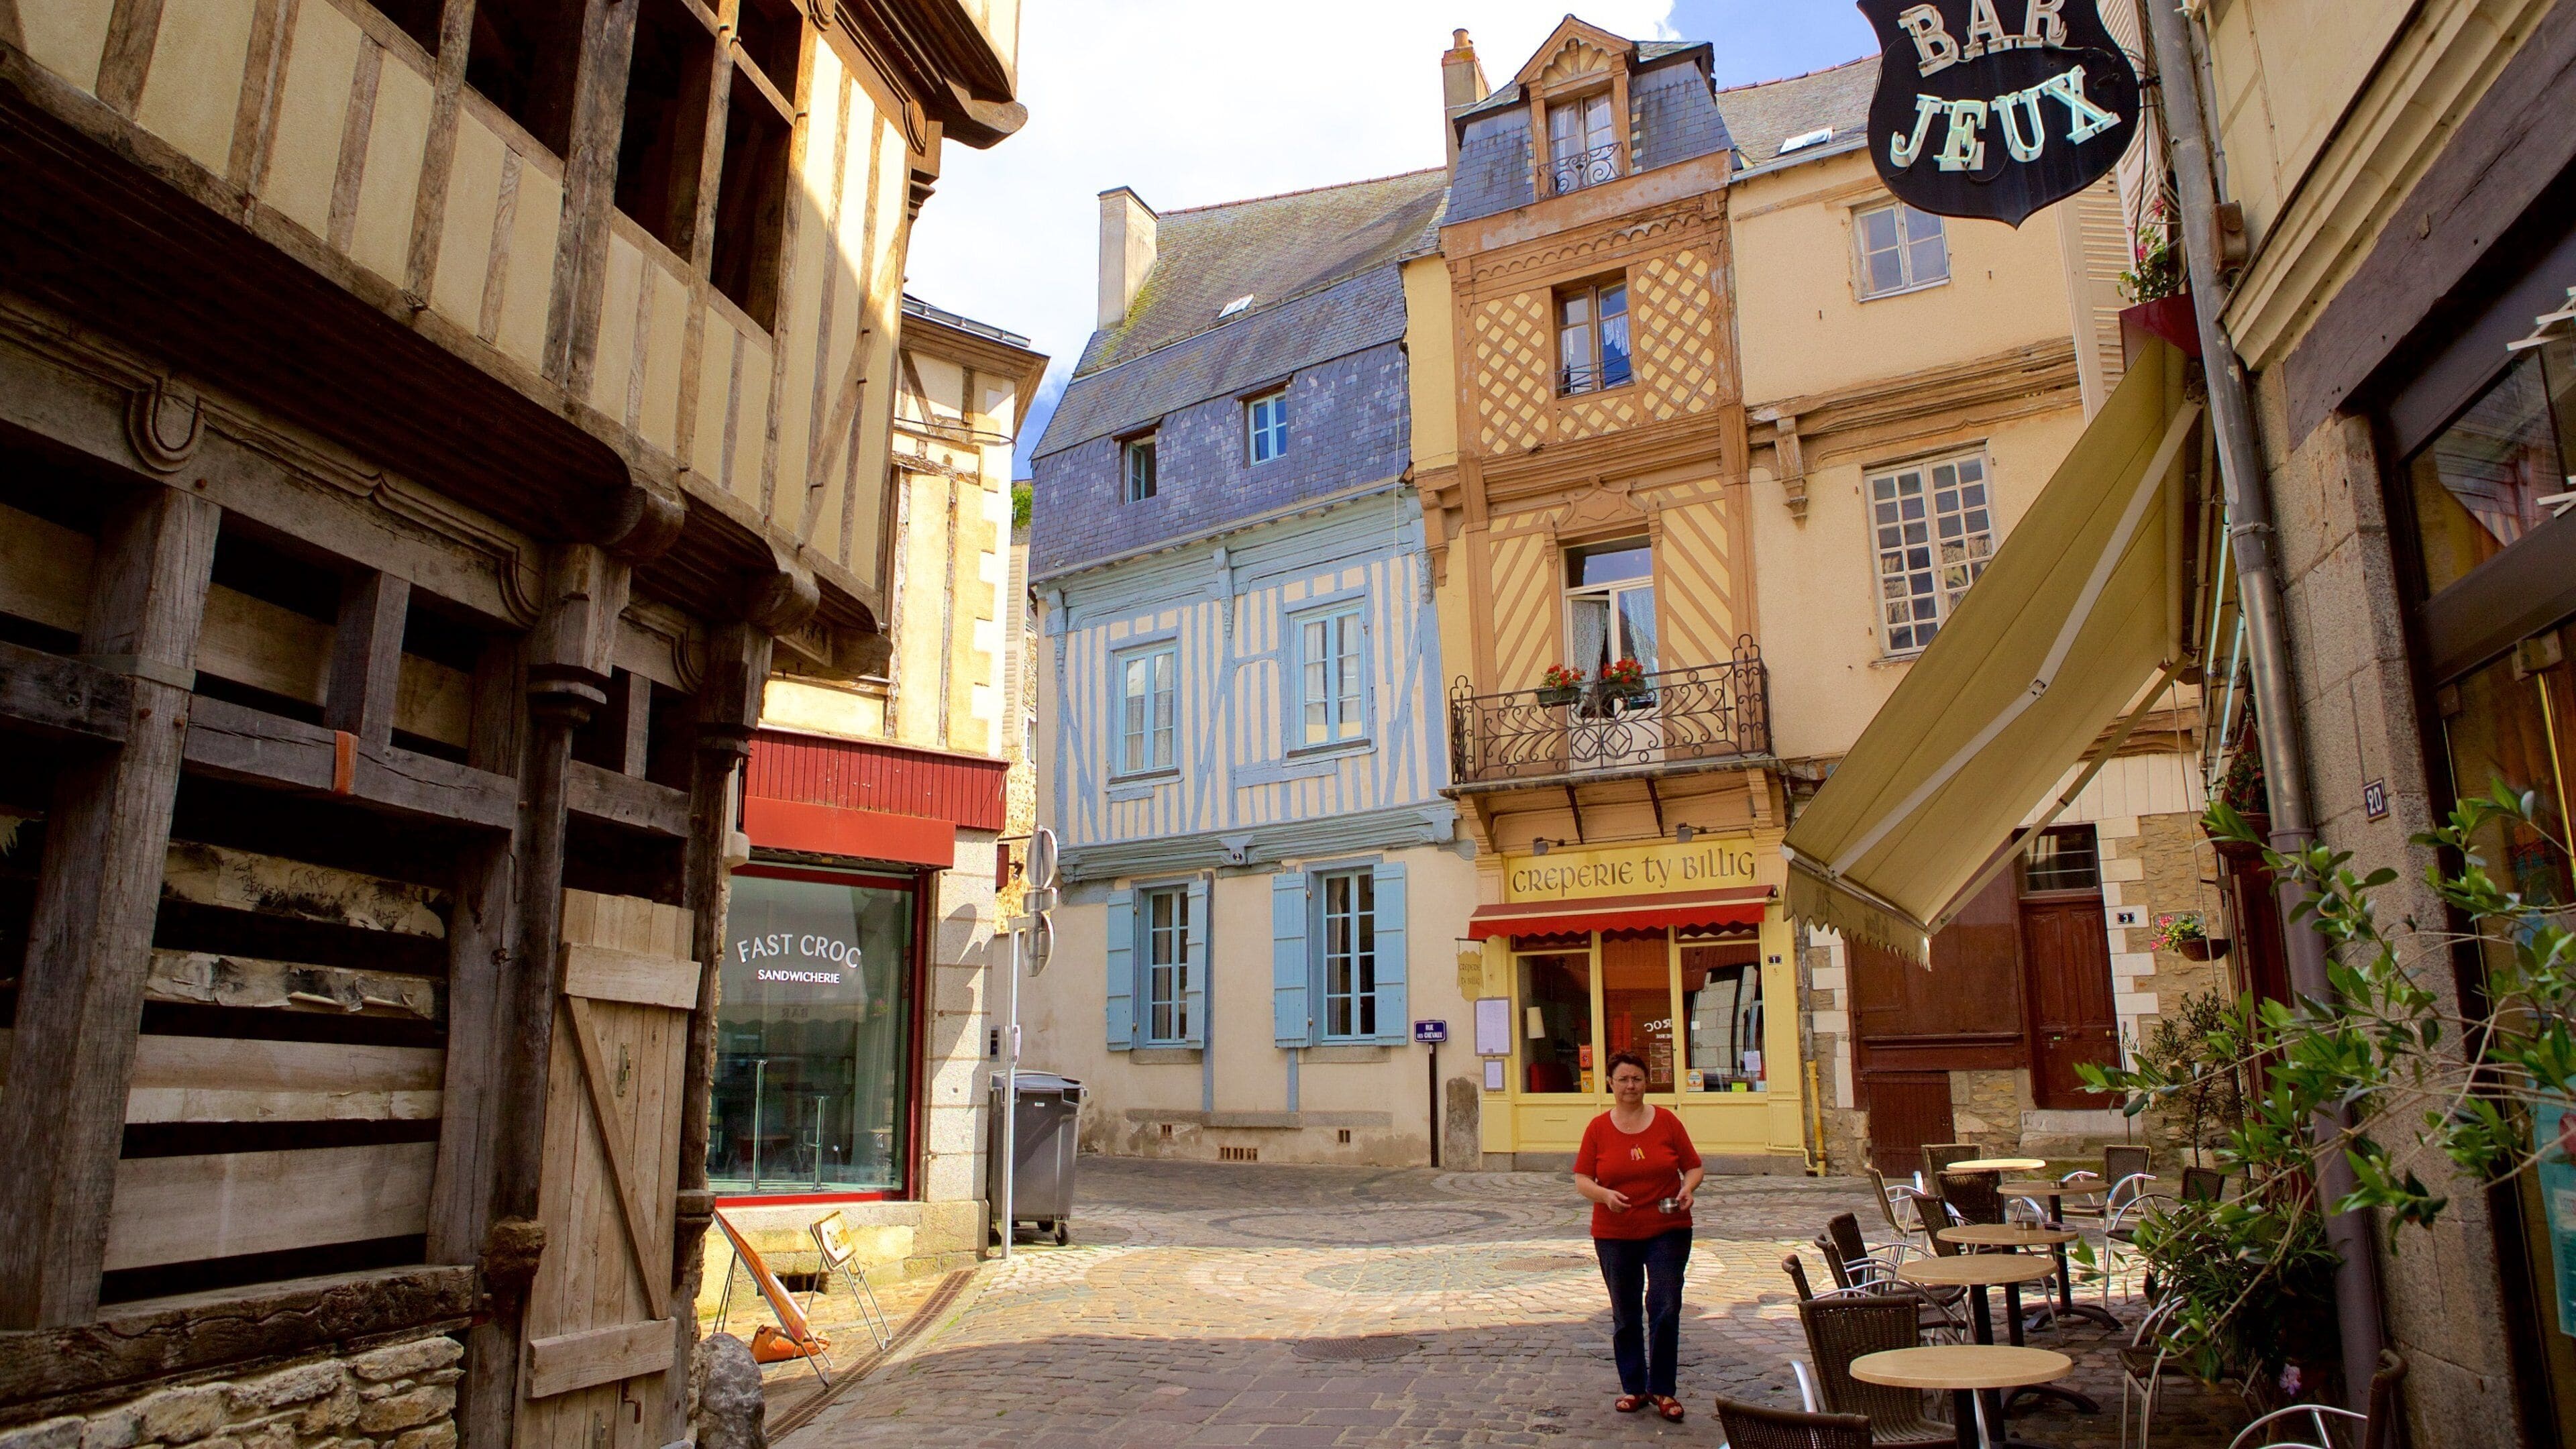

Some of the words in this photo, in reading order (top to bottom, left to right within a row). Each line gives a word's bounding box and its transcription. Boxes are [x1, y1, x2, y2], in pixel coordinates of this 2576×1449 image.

[1898, 0, 2068, 77] BAR
[1889, 64, 2121, 172] JEUX
[2367, 786, 2383, 814] 20
[1234, 853, 1240, 861] 2
[1512, 861, 1633, 897] CREPERIE
[2123, 914, 2129, 924] 3
[737, 933, 793, 963] FAST
[800, 934, 862, 969] CROC
[757, 969, 841, 984] SANDWICHERIE
